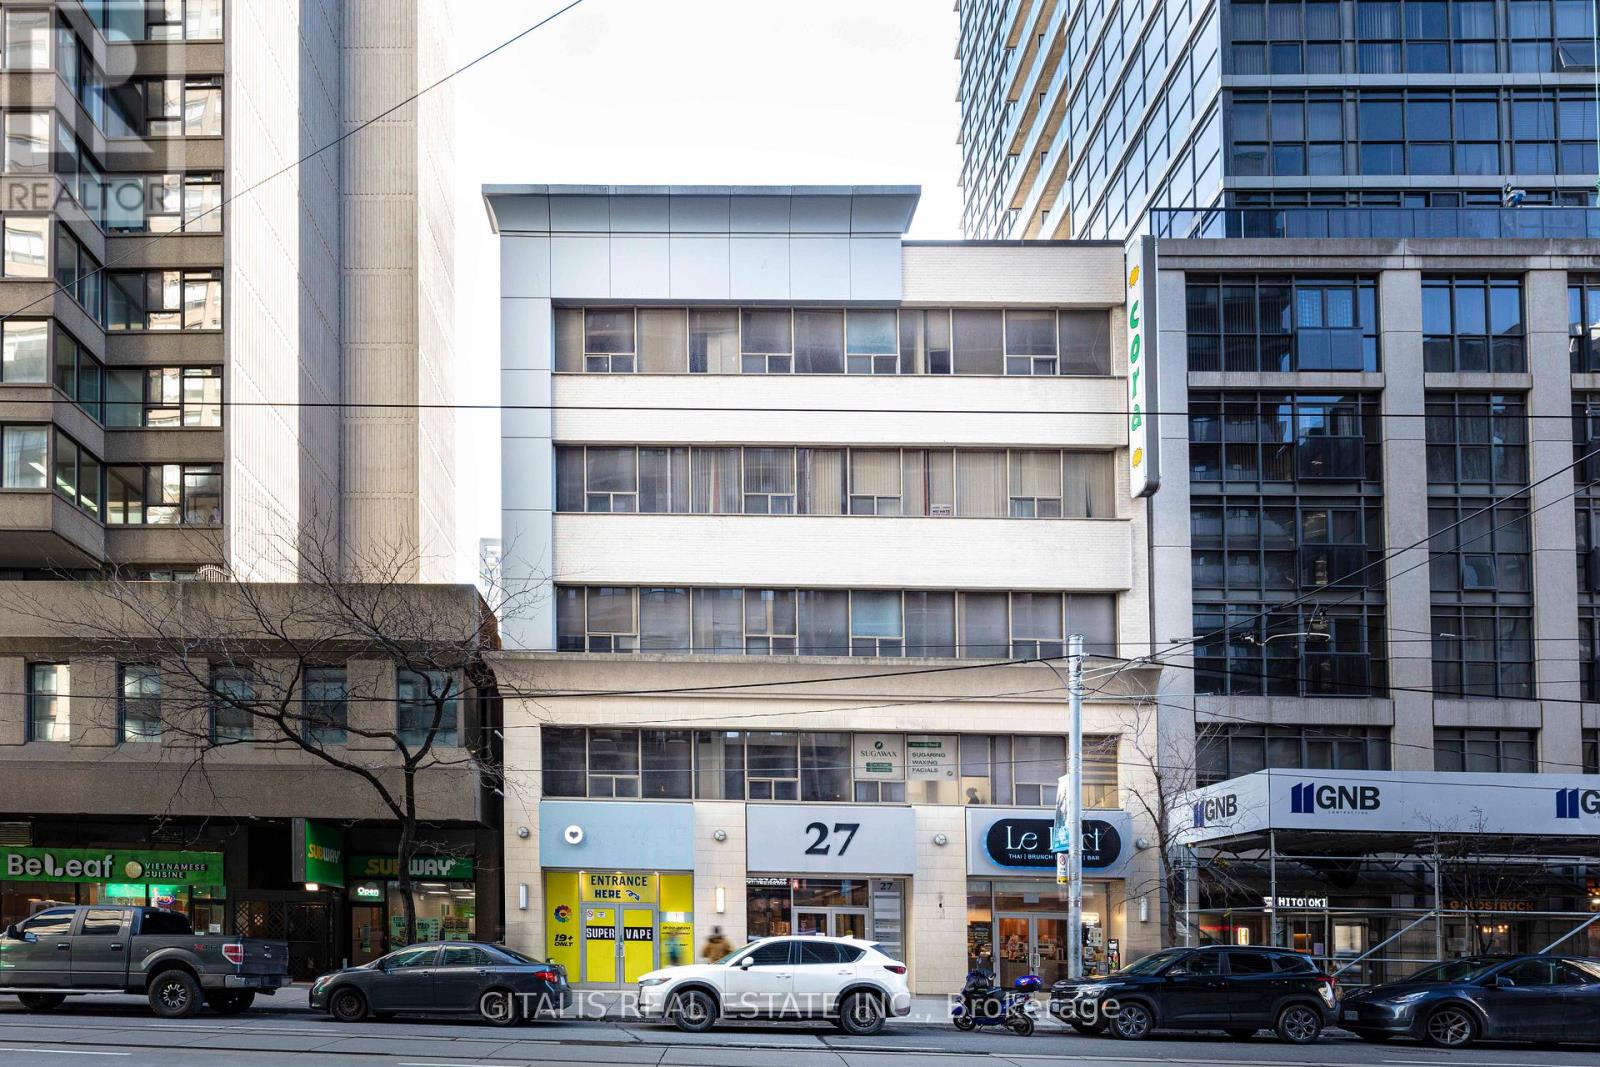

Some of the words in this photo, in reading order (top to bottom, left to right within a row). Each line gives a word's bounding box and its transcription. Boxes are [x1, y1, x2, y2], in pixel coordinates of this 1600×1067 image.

[860, 750, 897, 758] SUGAWAX
[1315, 785, 1381, 811] GNB
[1205, 793, 1238, 822] GNB
[804, 821, 860, 856] 27
[1005, 825, 1038, 850] Le
[307, 844, 342, 864] SUBWAY
[144, 862, 207, 871] VIETNAMESE
[144, 870, 185, 879] CUISINE
[590, 875, 648, 887] ENTRANCE
[880, 882, 894, 891] 27
[357, 887, 380, 897] Open
[594, 889, 621, 899] HERE
[554, 934, 574, 942] 19+
[586, 928, 615, 940] SUPER
[625, 928, 652, 940] VAPE
